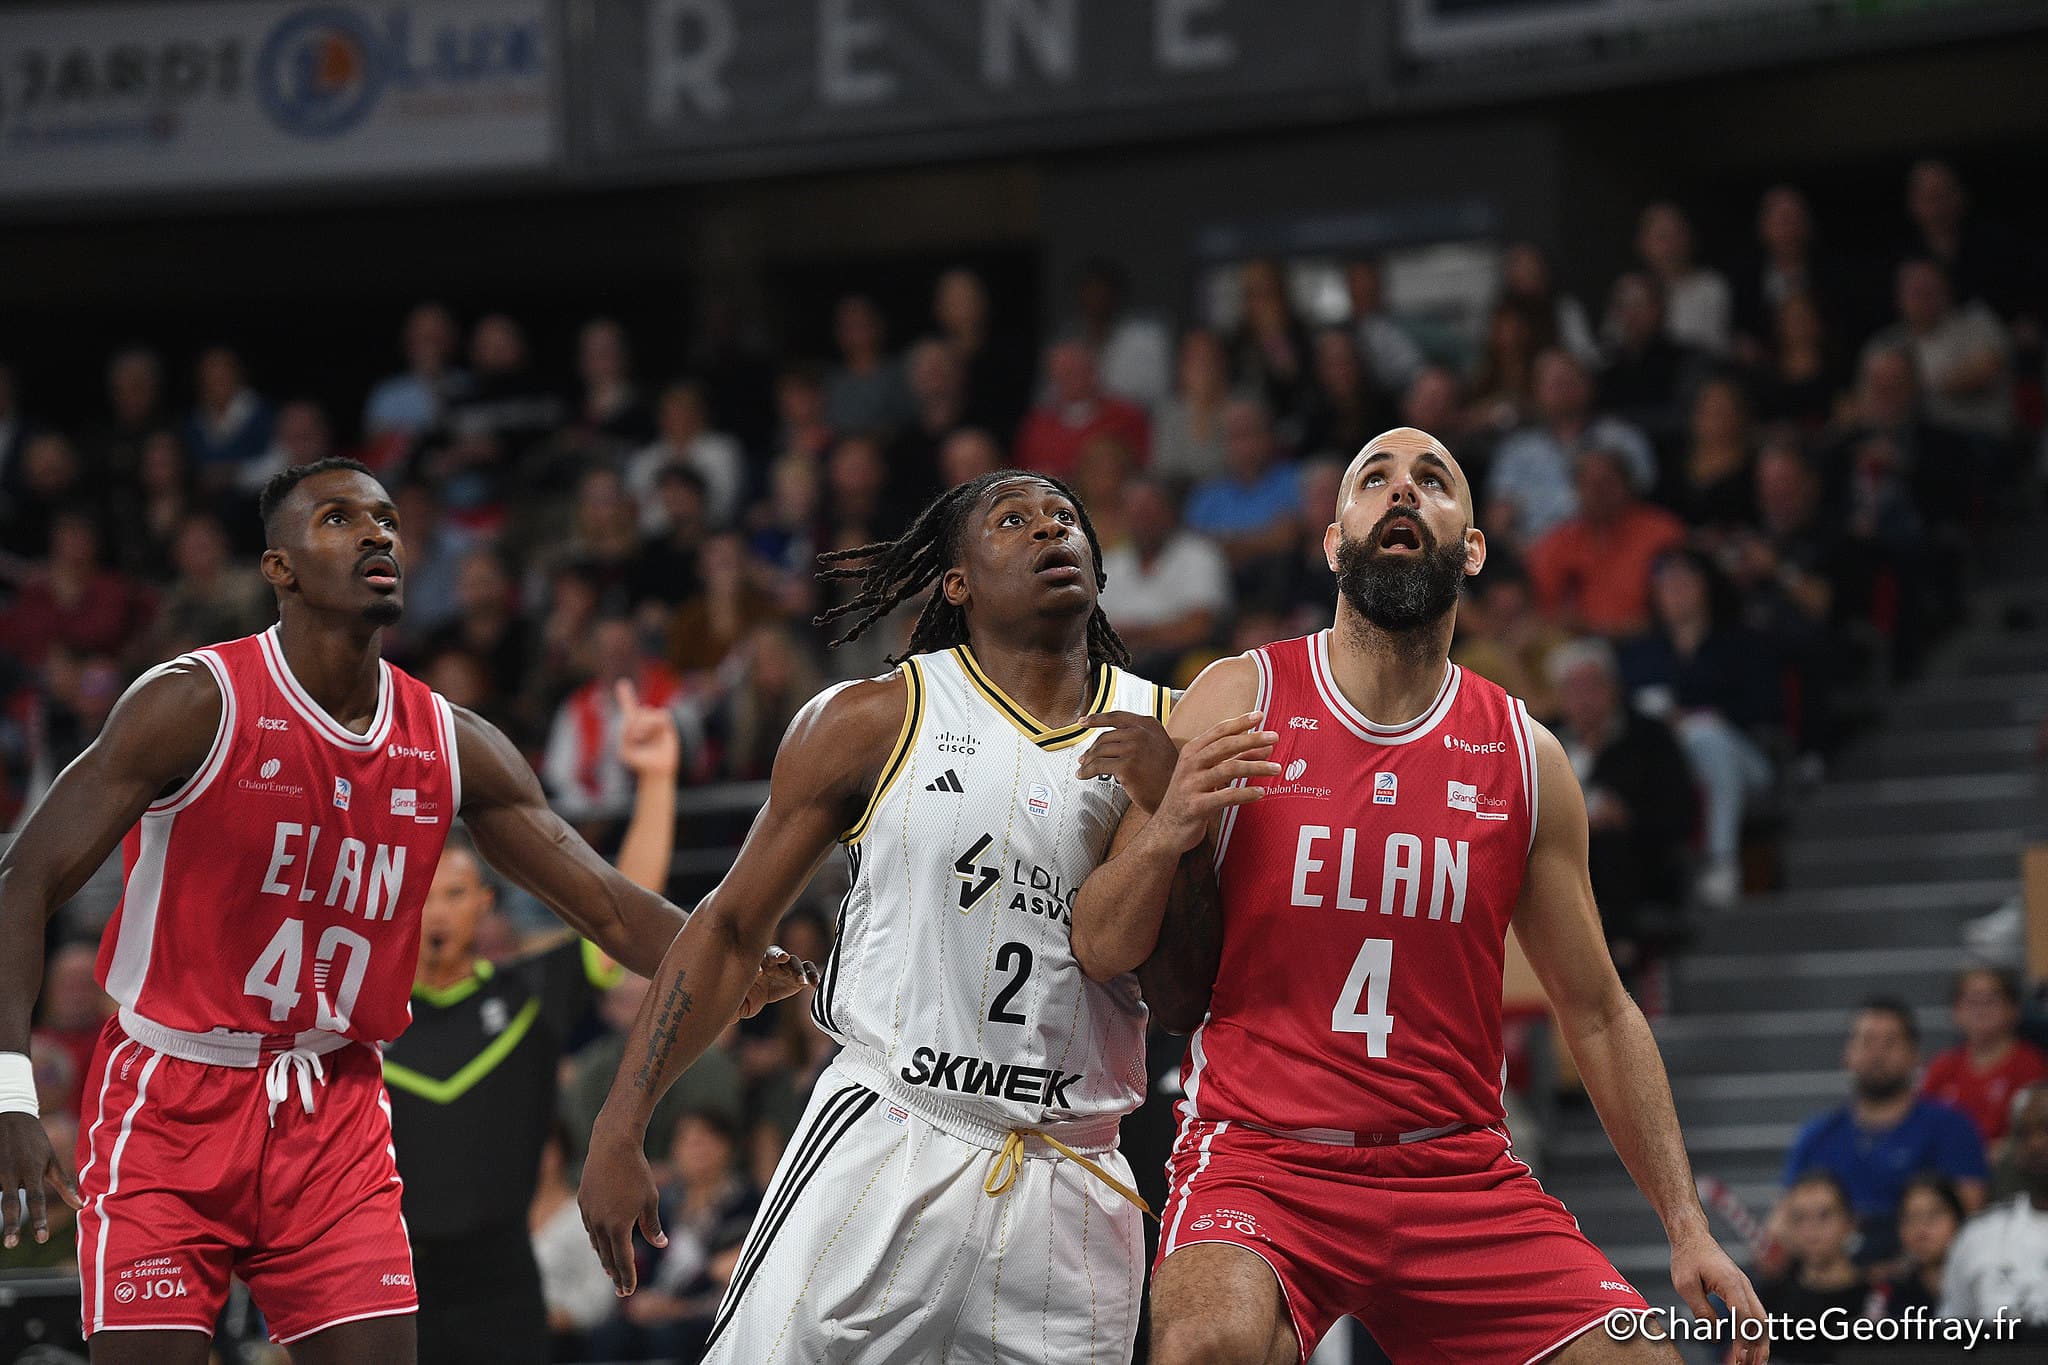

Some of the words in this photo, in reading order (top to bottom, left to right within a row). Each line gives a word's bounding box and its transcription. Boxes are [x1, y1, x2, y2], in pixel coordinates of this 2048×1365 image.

[1460, 740, 1506, 754] PAPREC
[1263, 782, 1332, 797] halon'Énergie
[1029, 806, 1045, 815] ELITE
[260, 821, 407, 921] ELAN
[1290, 824, 1470, 924] ELAN
[1008, 892, 1072, 927] ASV
[244, 917, 371, 1033] 40
[987, 941, 1034, 1026] 2
[1331, 938, 1394, 1058] 4
[900, 1046, 1084, 1110] SKWEK
[1216, 1208, 1256, 1221] CASINO
[121, 1270, 133, 1279] DE
[135, 1266, 182, 1278] SANTENAY
[134, 1257, 172, 1268] CASINO
[141, 1278, 188, 1300] JOA
